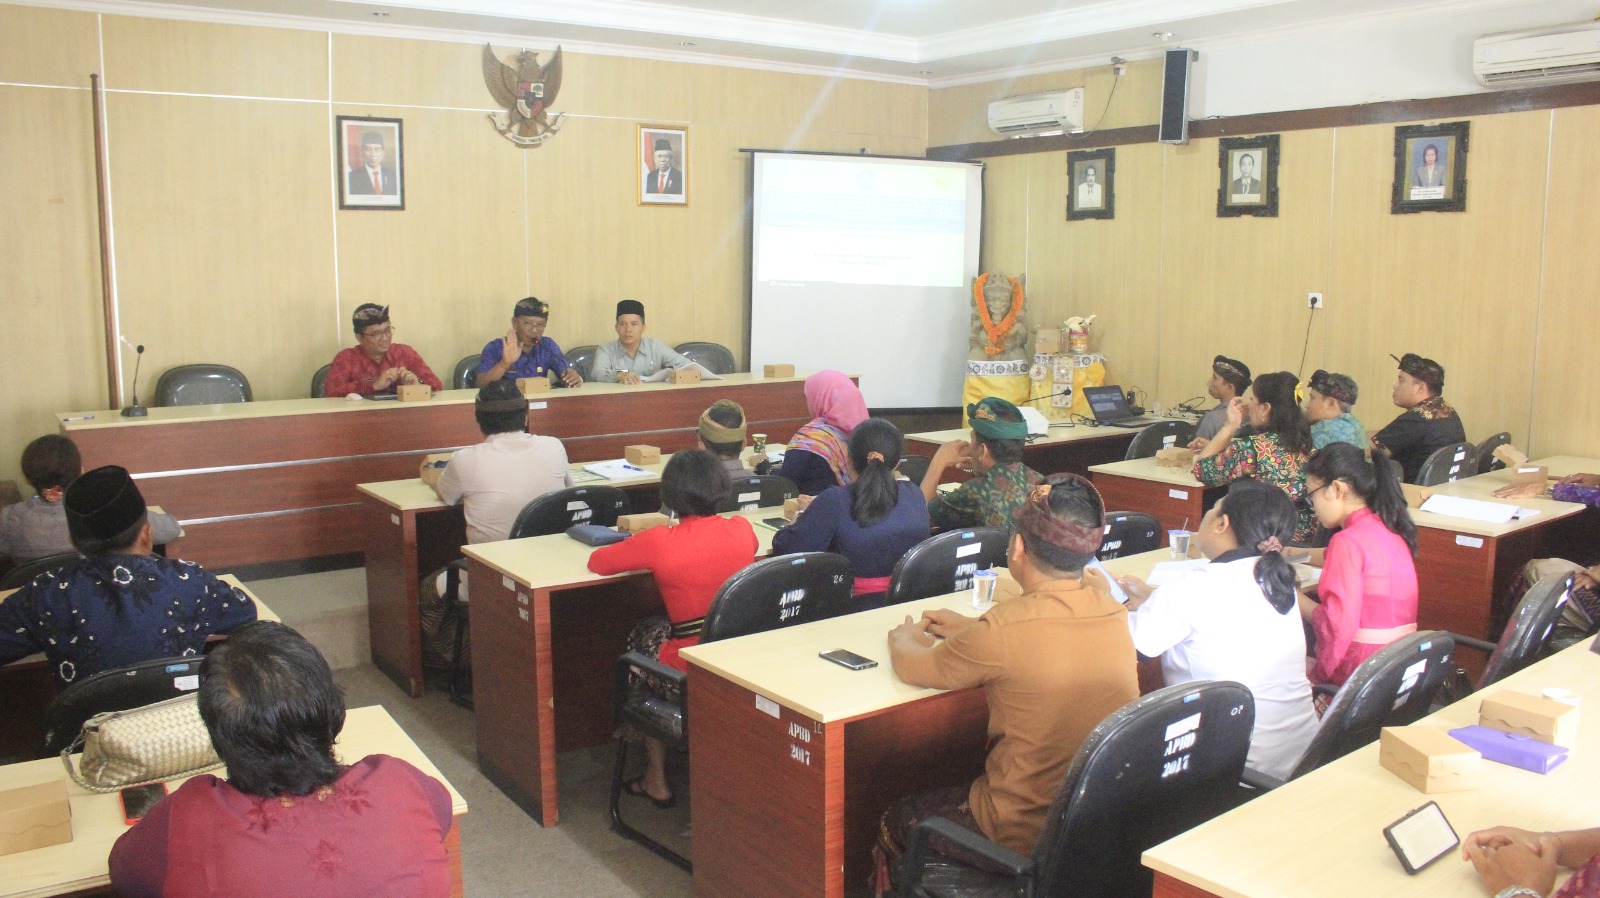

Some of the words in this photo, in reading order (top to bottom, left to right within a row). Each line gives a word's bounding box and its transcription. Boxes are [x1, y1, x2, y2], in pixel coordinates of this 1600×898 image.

[779, 605, 801, 622] 2017
[788, 721, 811, 743] APBD
[790, 743, 811, 766] 2017
[1164, 732, 1197, 757] APBD
[1161, 753, 1191, 778] 2017
